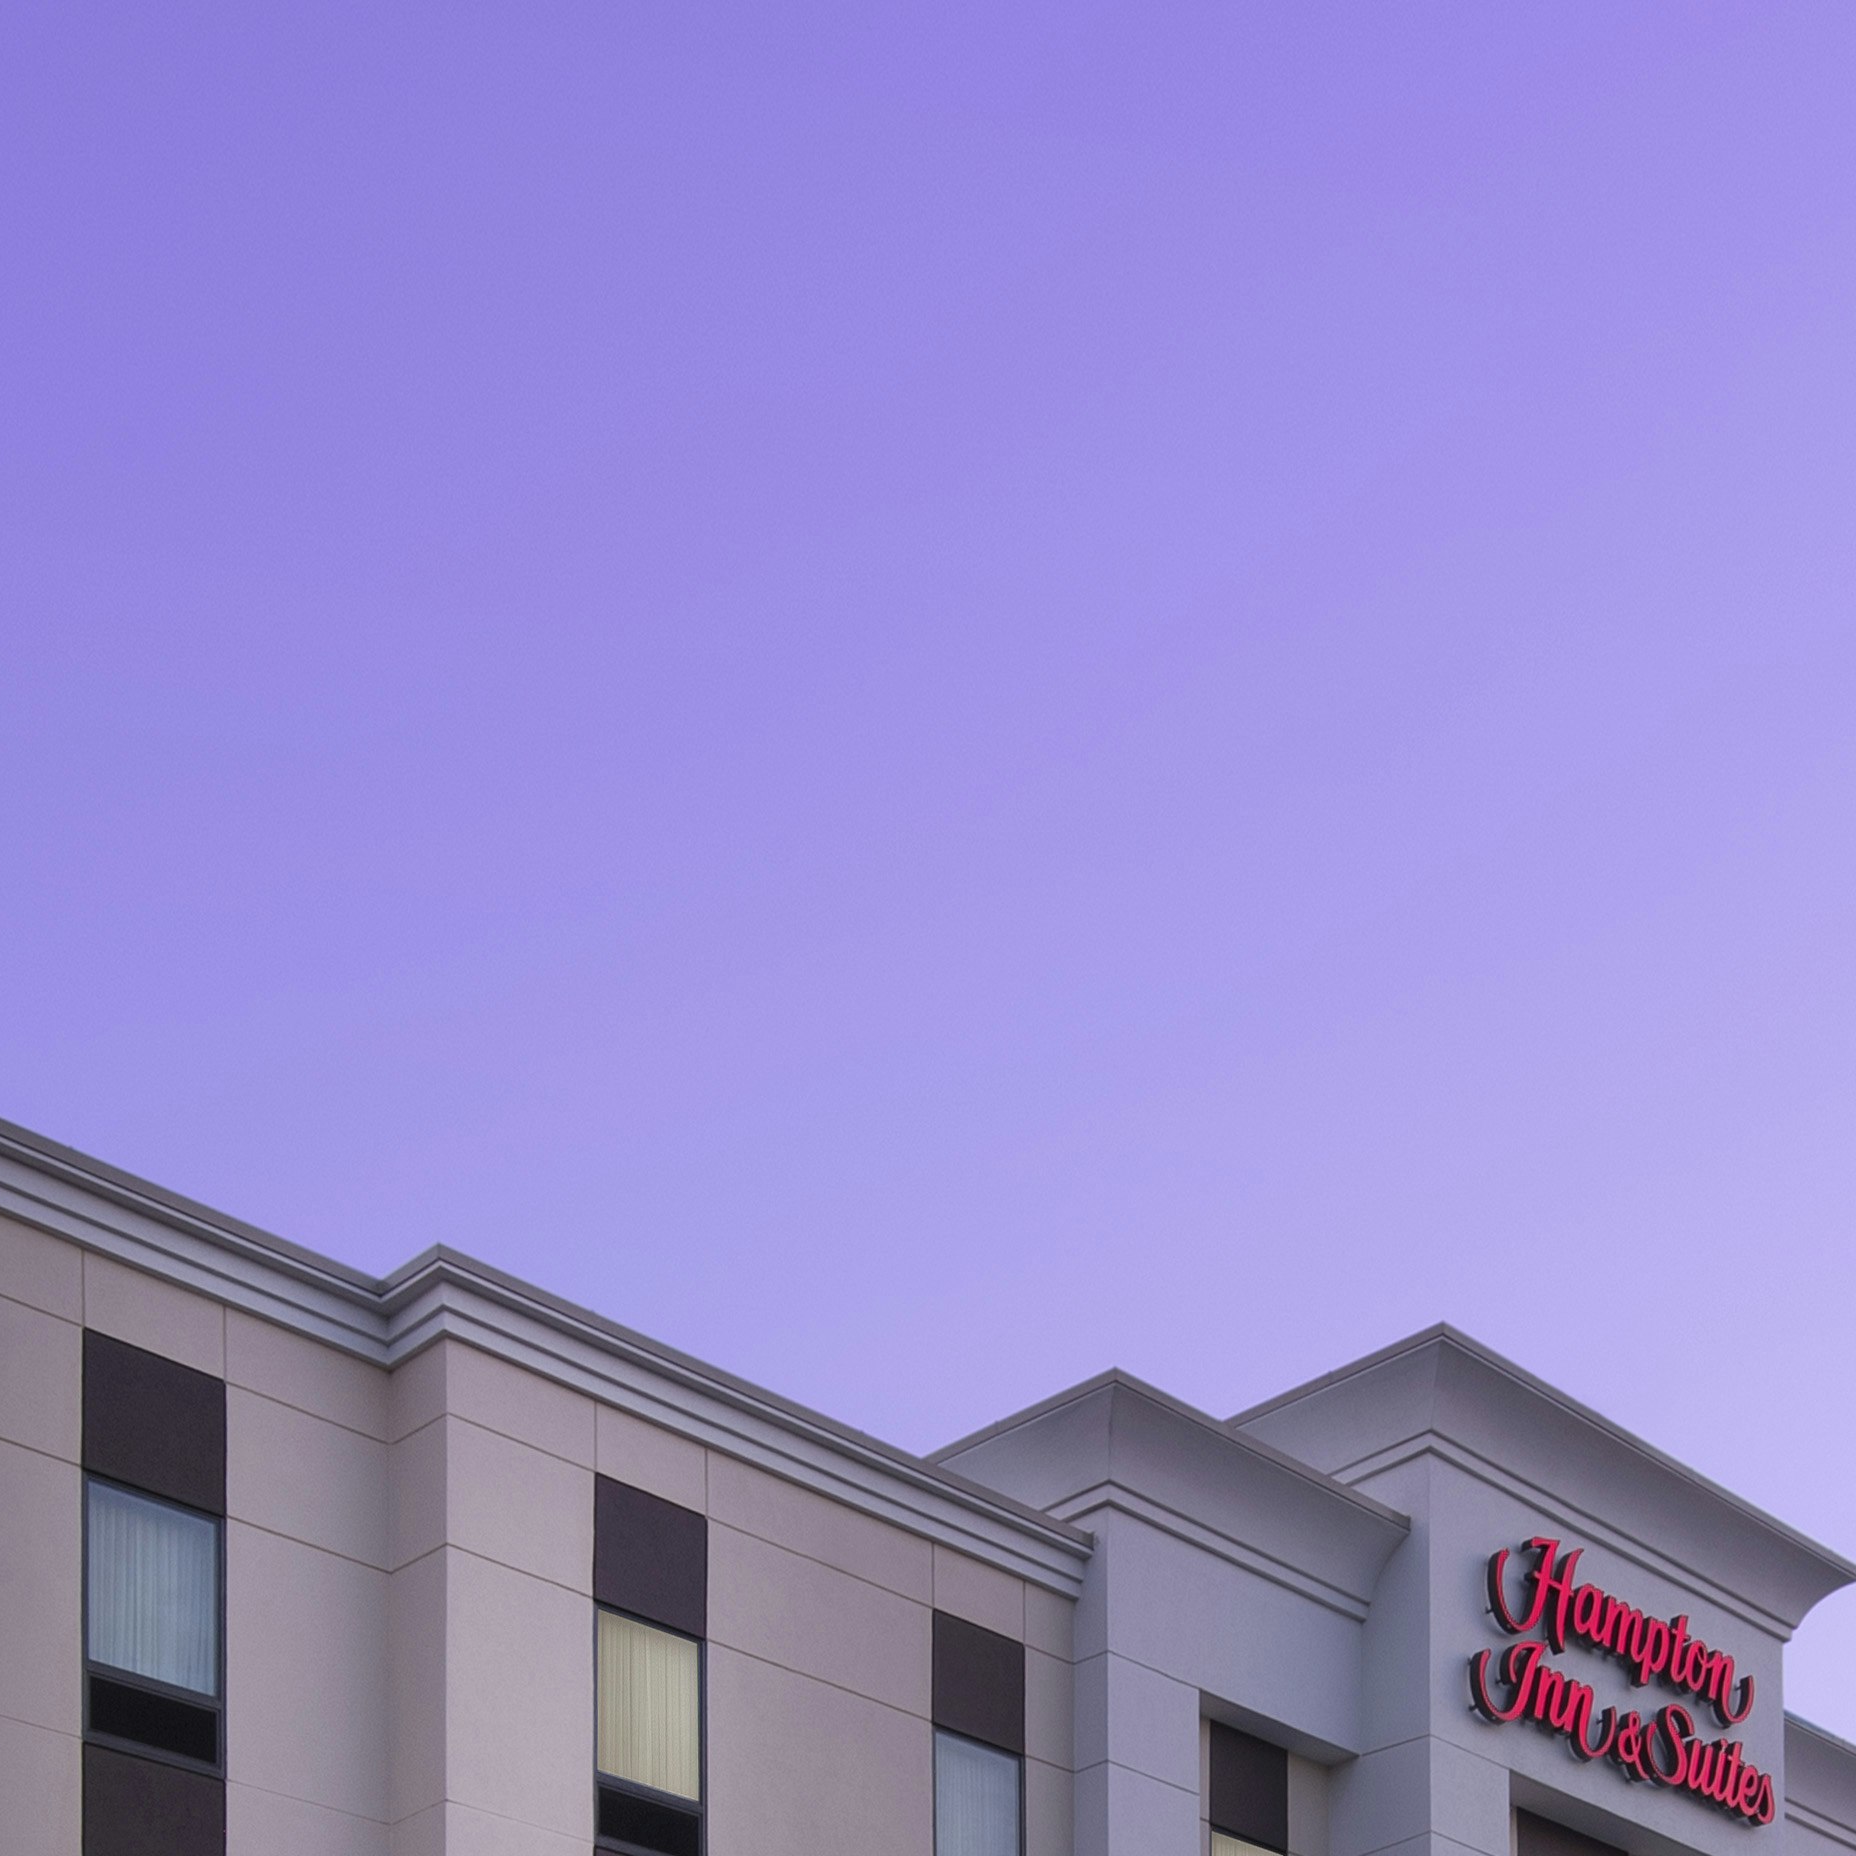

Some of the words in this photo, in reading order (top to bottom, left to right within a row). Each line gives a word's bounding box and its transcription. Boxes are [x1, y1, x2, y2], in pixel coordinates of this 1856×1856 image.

[1487, 1536, 1755, 1728] Hampton
[1469, 1640, 1617, 1763] Inn
[1616, 1710, 1651, 1782] &
[1644, 1703, 1776, 1827] Suites
